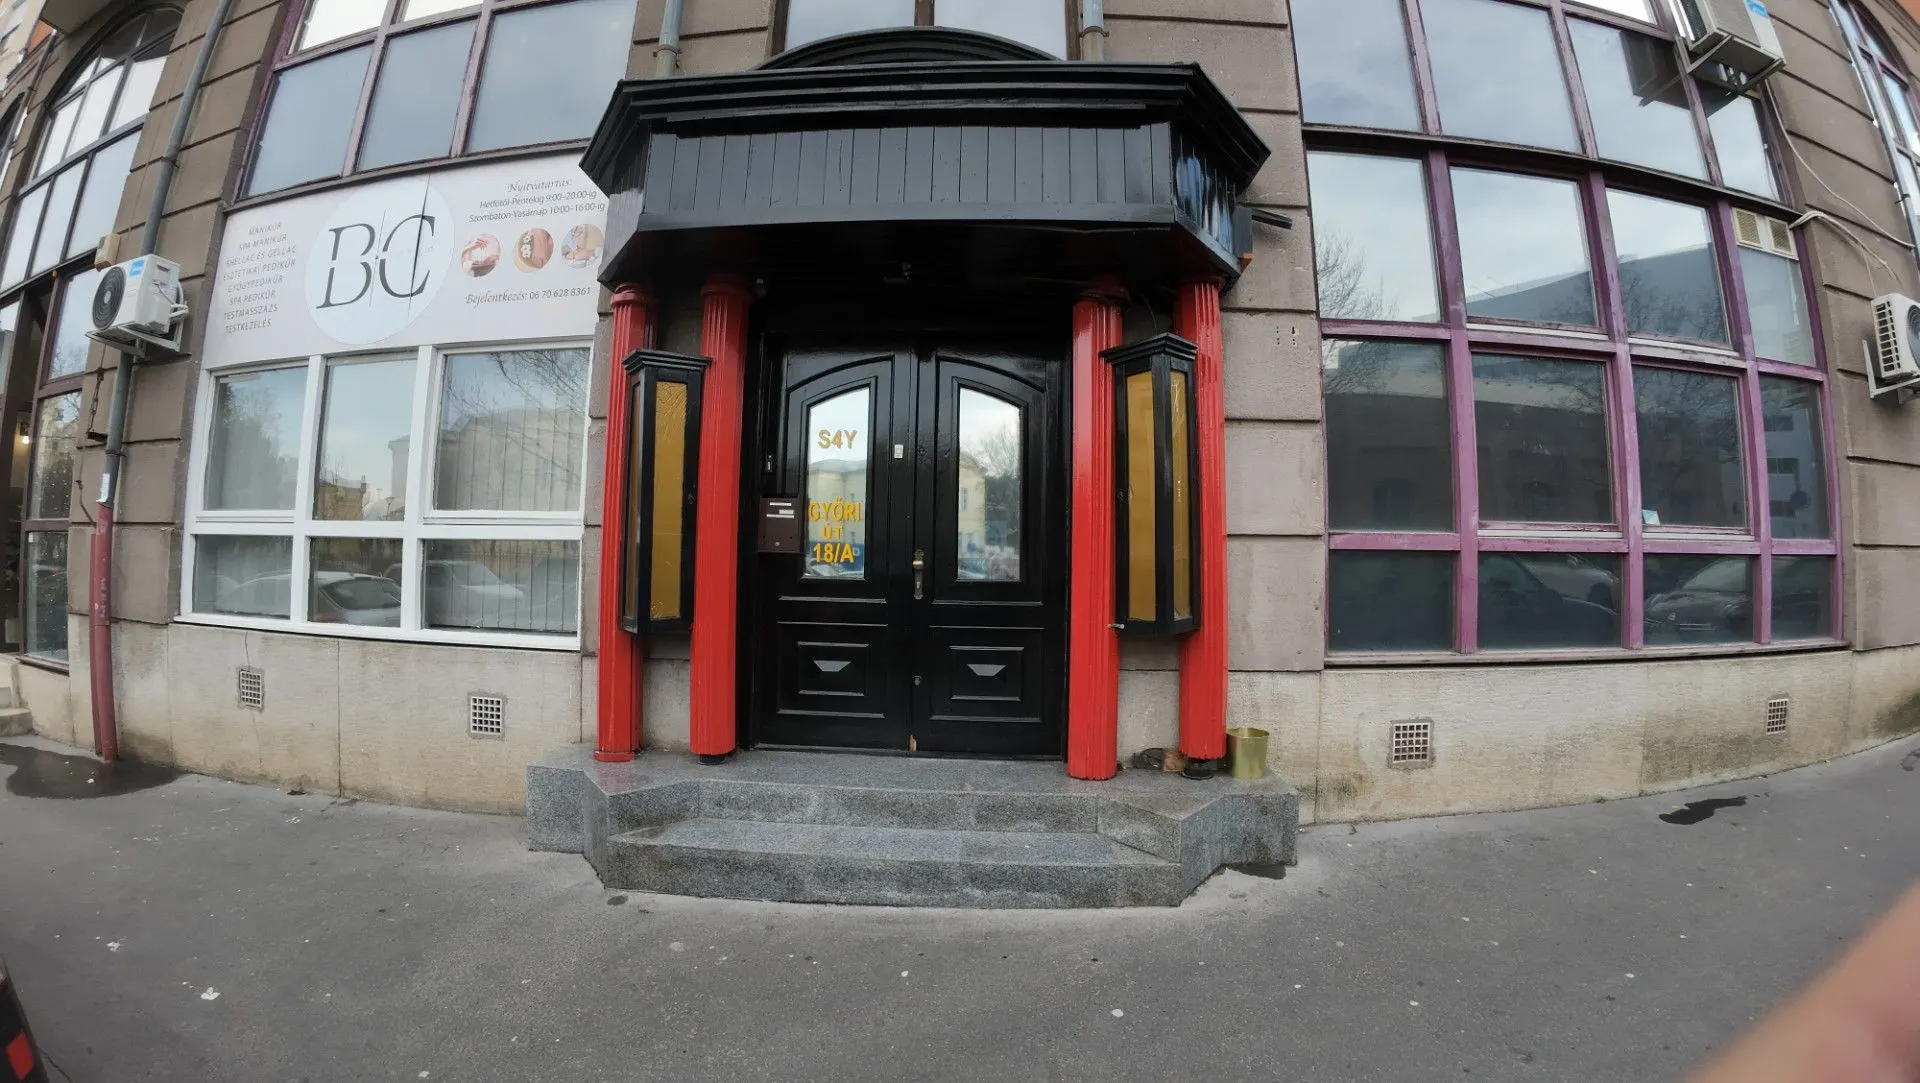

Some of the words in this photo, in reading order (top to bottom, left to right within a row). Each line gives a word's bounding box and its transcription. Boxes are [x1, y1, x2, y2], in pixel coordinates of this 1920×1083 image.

[530, 290, 540, 301] 06
[542, 288, 552, 300] 70
[553, 287, 569, 299] 628
[570, 286, 591, 298] 8361
[818, 430, 858, 449] S4Y
[807, 496, 862, 523] GYŐRI
[813, 542, 855, 564] 18/A
